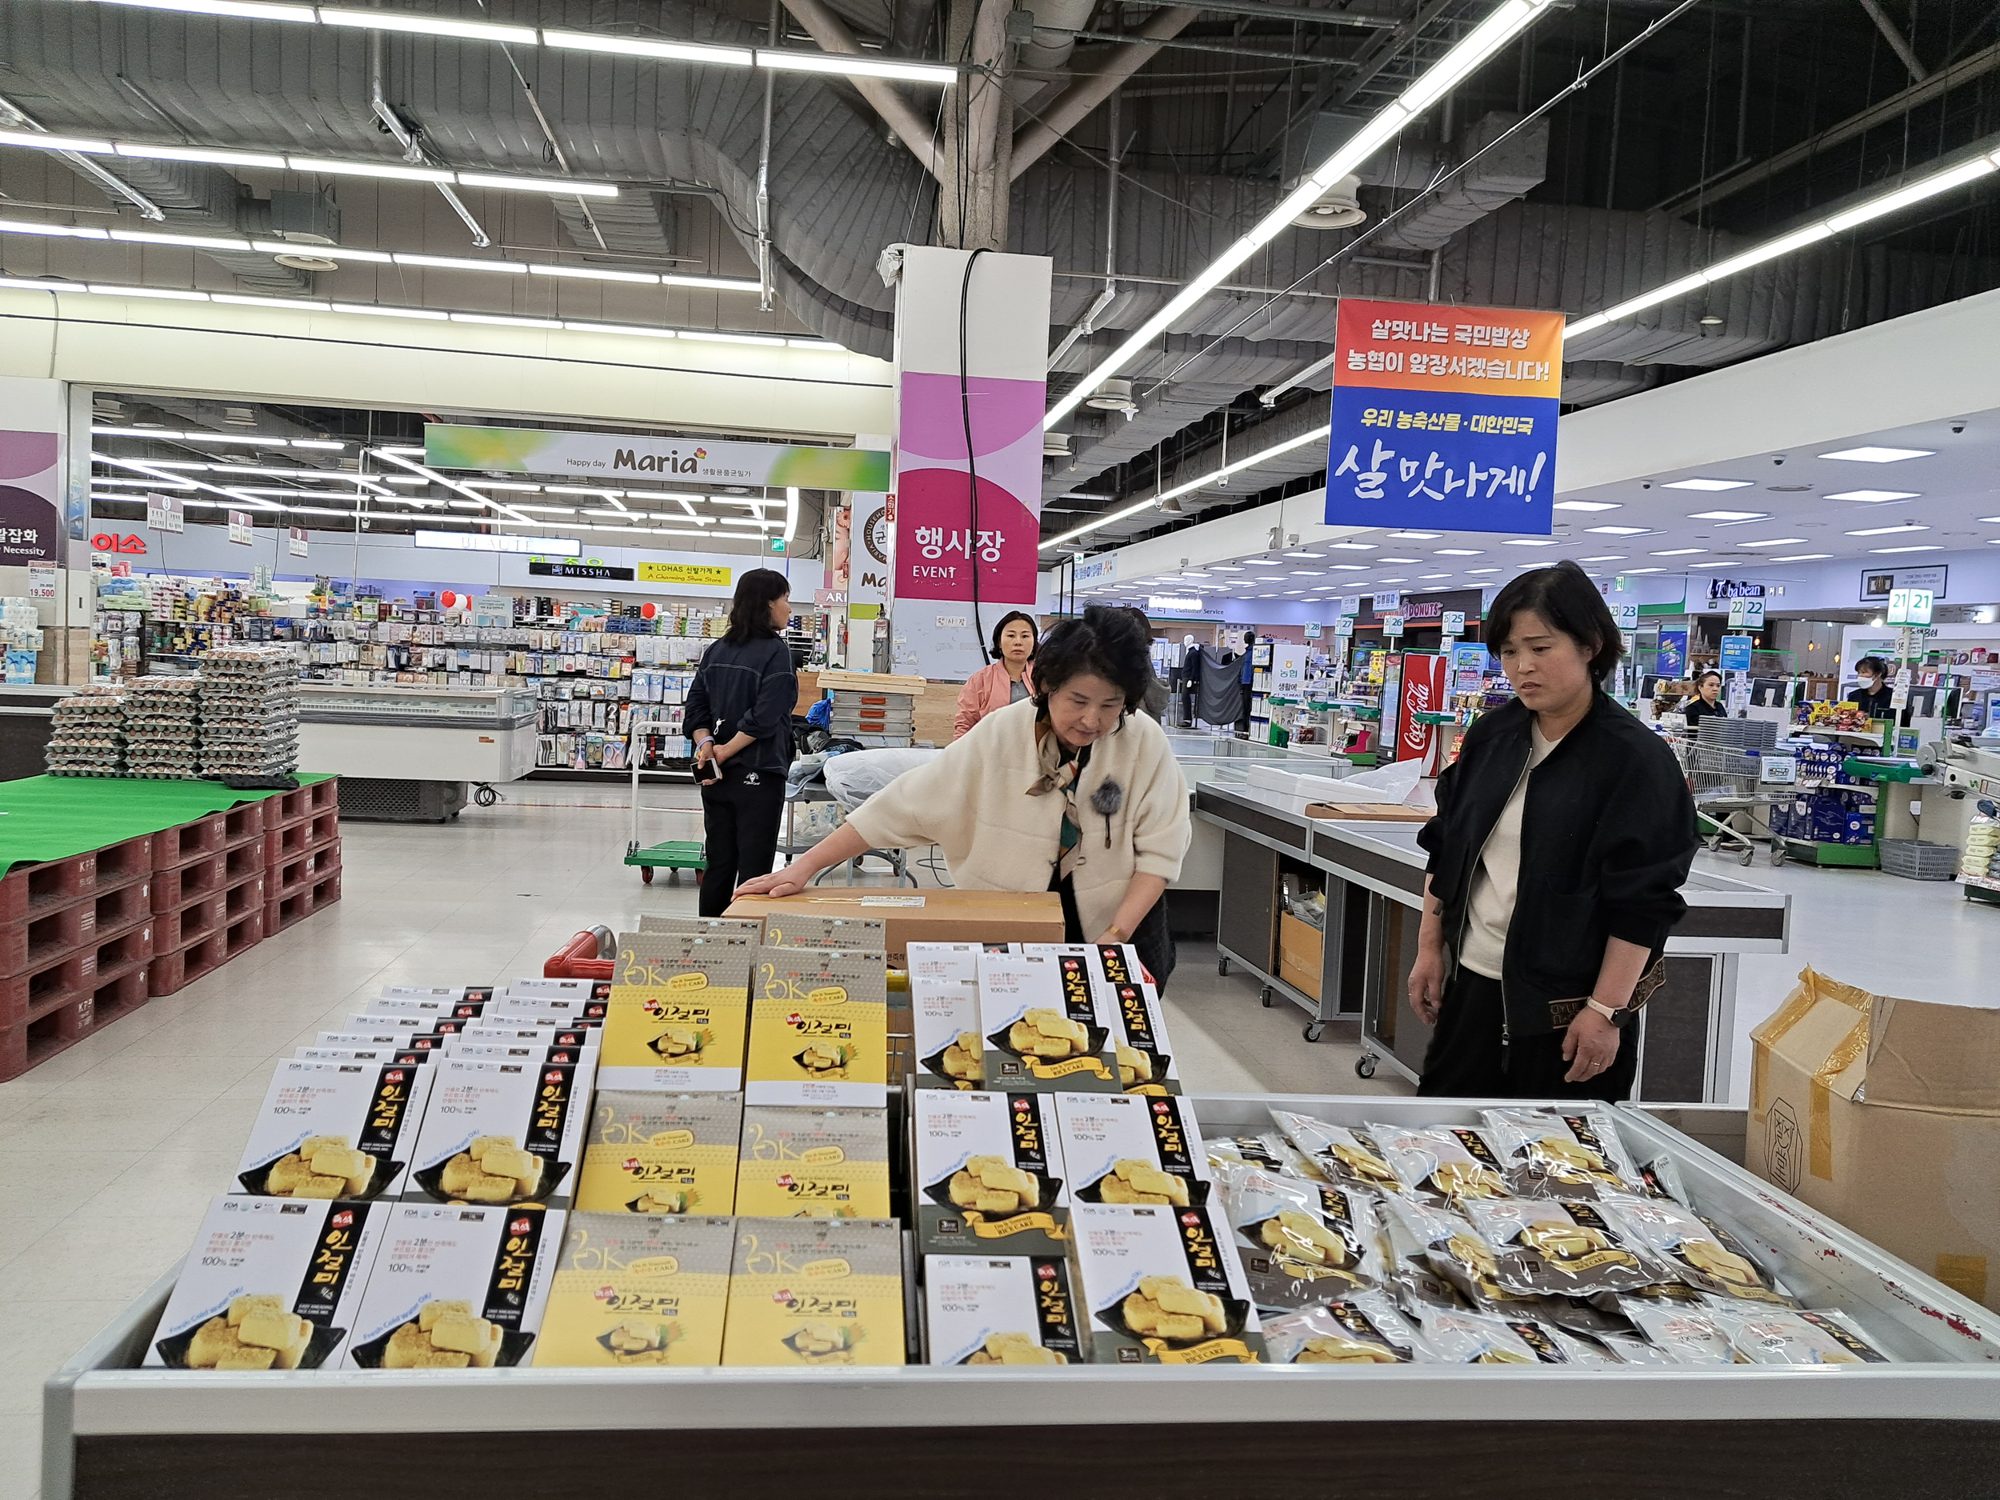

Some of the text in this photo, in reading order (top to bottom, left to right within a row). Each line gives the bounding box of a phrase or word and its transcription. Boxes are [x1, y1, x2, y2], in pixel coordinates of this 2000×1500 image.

[1371, 319, 1530, 350] 살맛나는 국민밥상
[1347, 349, 1550, 382] 농협이 앞장서겠습니다!
[1360, 408, 1534, 436] 우리 농축산물 대한민국
[566, 457, 591, 467] Happy
[592, 460, 606, 469] day
[613, 447, 698, 475] Maria
[3, 545, 46, 557] Necessity
[92, 533, 147, 554] 이소
[914, 526, 1006, 563] 행사장
[564, 566, 611, 577] MISSHA
[656, 564, 713, 575] LOHAS 신발가게
[912, 566, 957, 579] EVENT
[1731, 601, 1762, 614] 22 22
[1893, 594, 1929, 609] 21 21
[1408, 602, 1441, 618] DONUTS
[1623, 606, 1636, 617] 23
[1311, 623, 1320, 631] 28
[1343, 619, 1352, 628] 27
[1392, 618, 1403, 627] 26
[1452, 614, 1463, 624] 25
[1280, 669, 1298, 678] 농협
[1106, 959, 1126, 984] 인절
[1067, 972, 1087, 1003] 인절미
[653, 1006, 710, 1021] 인절미
[1125, 998, 1147, 1031] 인절미
[796, 1020, 852, 1034] 인절미
[372, 1085, 405, 1128] 인절미
[537, 1085, 566, 1129] 인절미
[1016, 1112, 1038, 1150] 인절미
[1157, 1116, 1182, 1153] 인절미
[632, 1165, 695, 1180] 인절미
[788, 1182, 849, 1196] 인절미
[1186, 1227, 1216, 1268] 인절미
[312, 1230, 352, 1285] 인절미
[498, 1236, 533, 1291] 인절미
[606, 1294, 679, 1311] 인절미
[786, 1298, 856, 1313] 인절미
[1040, 1280, 1067, 1325] 인절미
